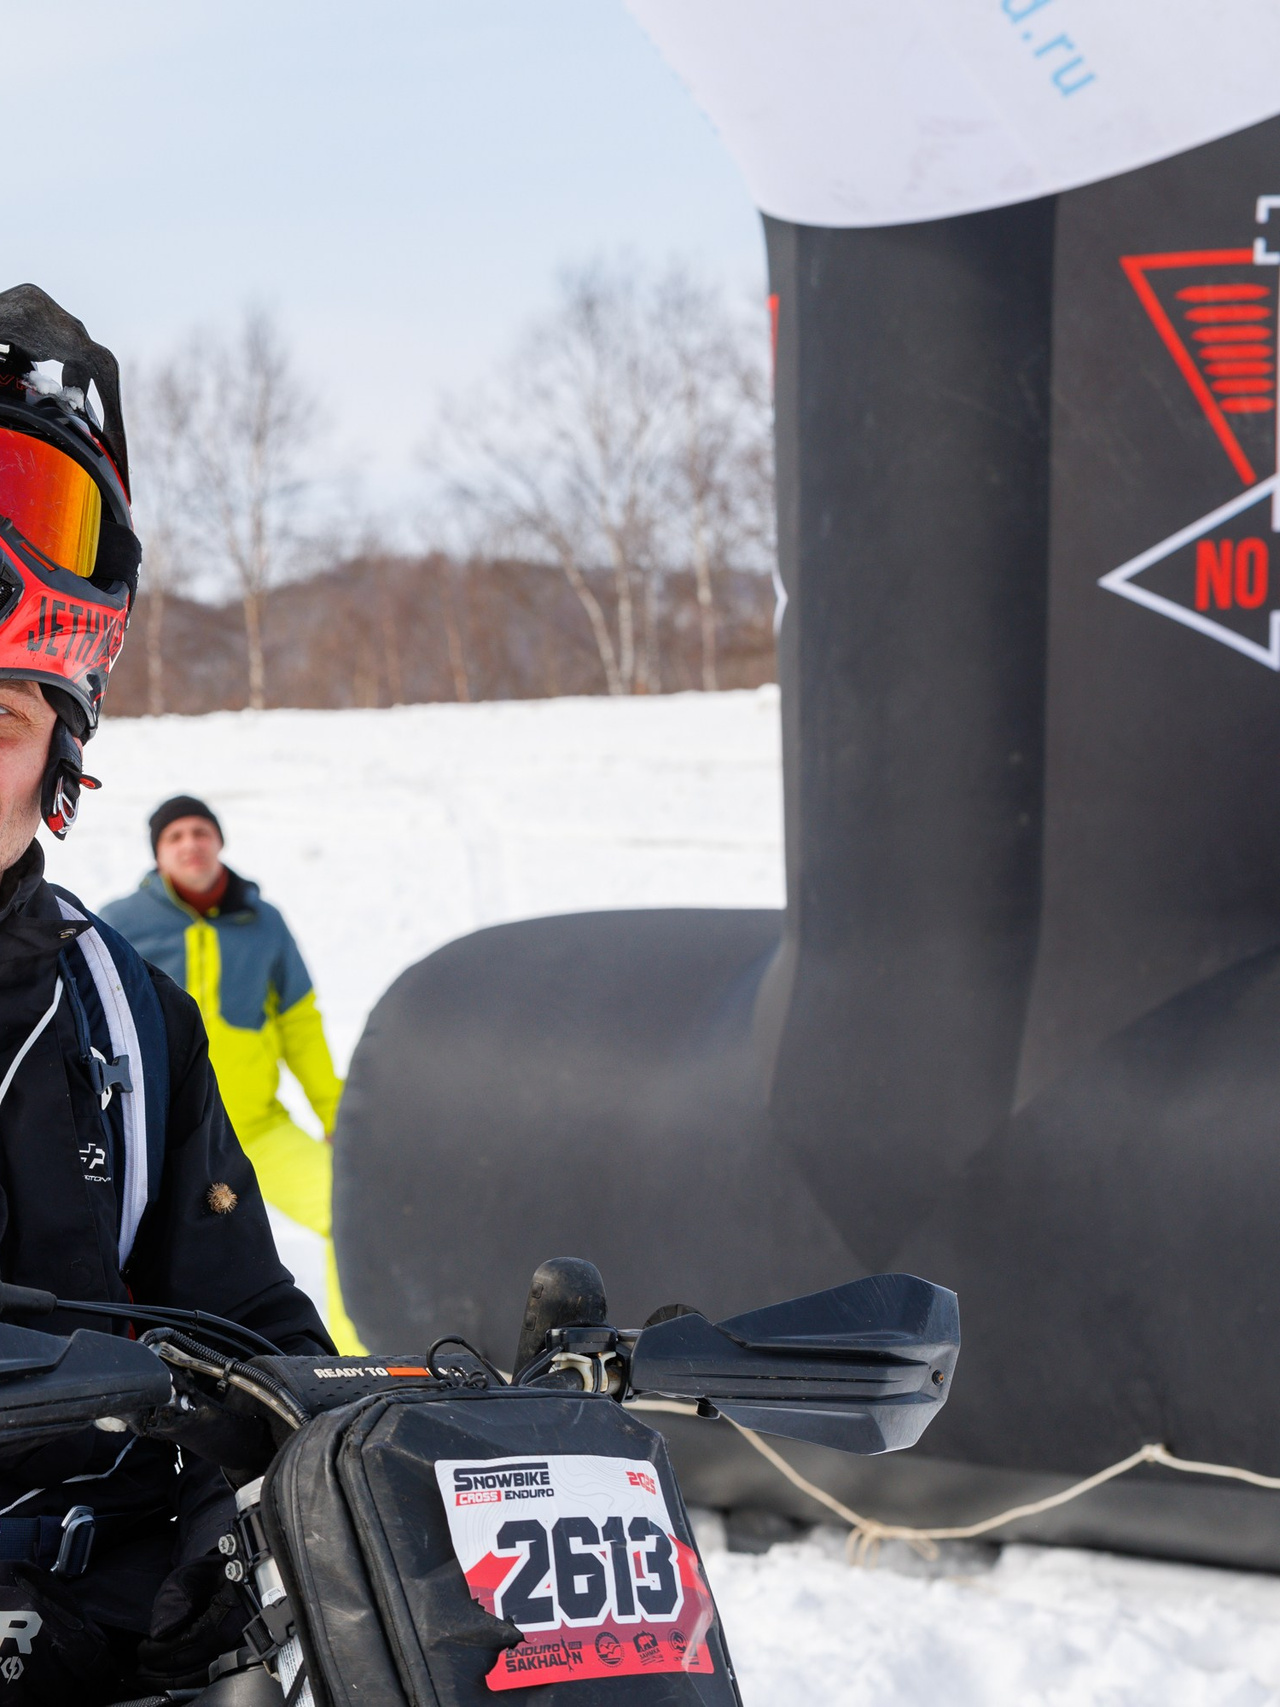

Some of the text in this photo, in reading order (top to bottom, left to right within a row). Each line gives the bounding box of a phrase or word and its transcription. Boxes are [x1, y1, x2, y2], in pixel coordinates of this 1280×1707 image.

[1195, 537, 1269, 611] NO
[314, 1367, 389, 1378] READY TO
[458, 1488, 554, 1505] CROSS ENDURO
[497, 1516, 678, 1624] 2613
[506, 1643, 560, 1659] ENDURO
